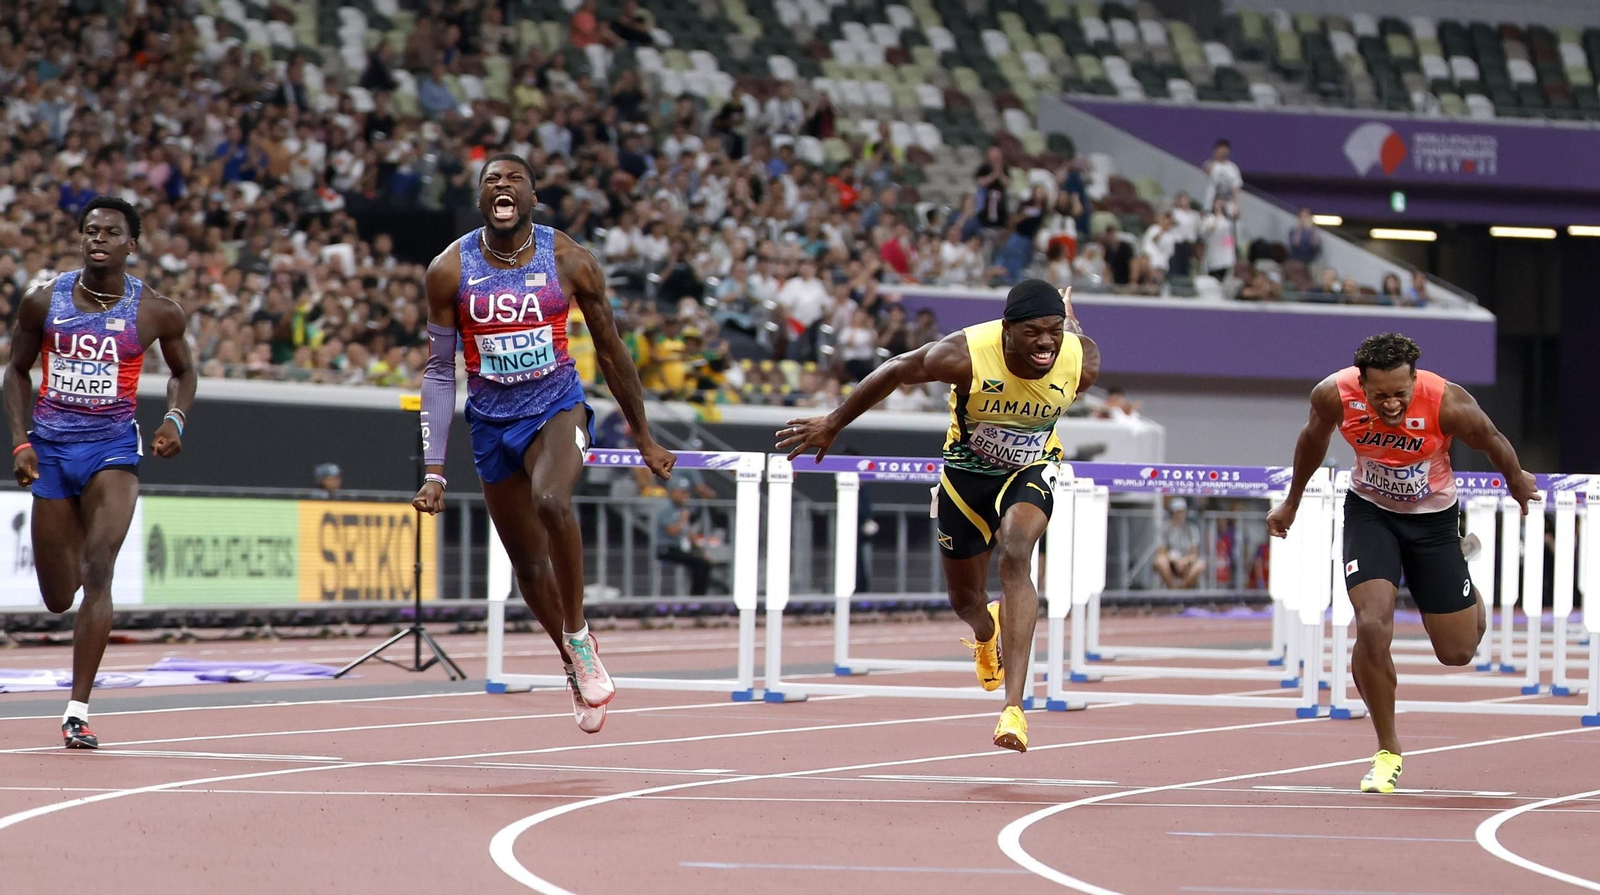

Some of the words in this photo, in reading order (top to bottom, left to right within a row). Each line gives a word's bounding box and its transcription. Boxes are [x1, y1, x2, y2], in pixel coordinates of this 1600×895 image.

[468, 293, 543, 323] USA
[54, 332, 119, 363] USA
[494, 329, 547, 351] TDK
[66, 360, 112, 376] TDK
[486, 347, 548, 371] TINCH
[51, 373, 112, 394] THARP
[978, 399, 1062, 418] JAMAICA
[974, 435, 1040, 463] BENNETT
[1000, 430, 1044, 447] TDK
[1355, 431, 1424, 452] JAPAN
[1365, 469, 1427, 493] MURATAKE
[1378, 461, 1425, 480] TDK
[320, 512, 416, 600] SEIKO
